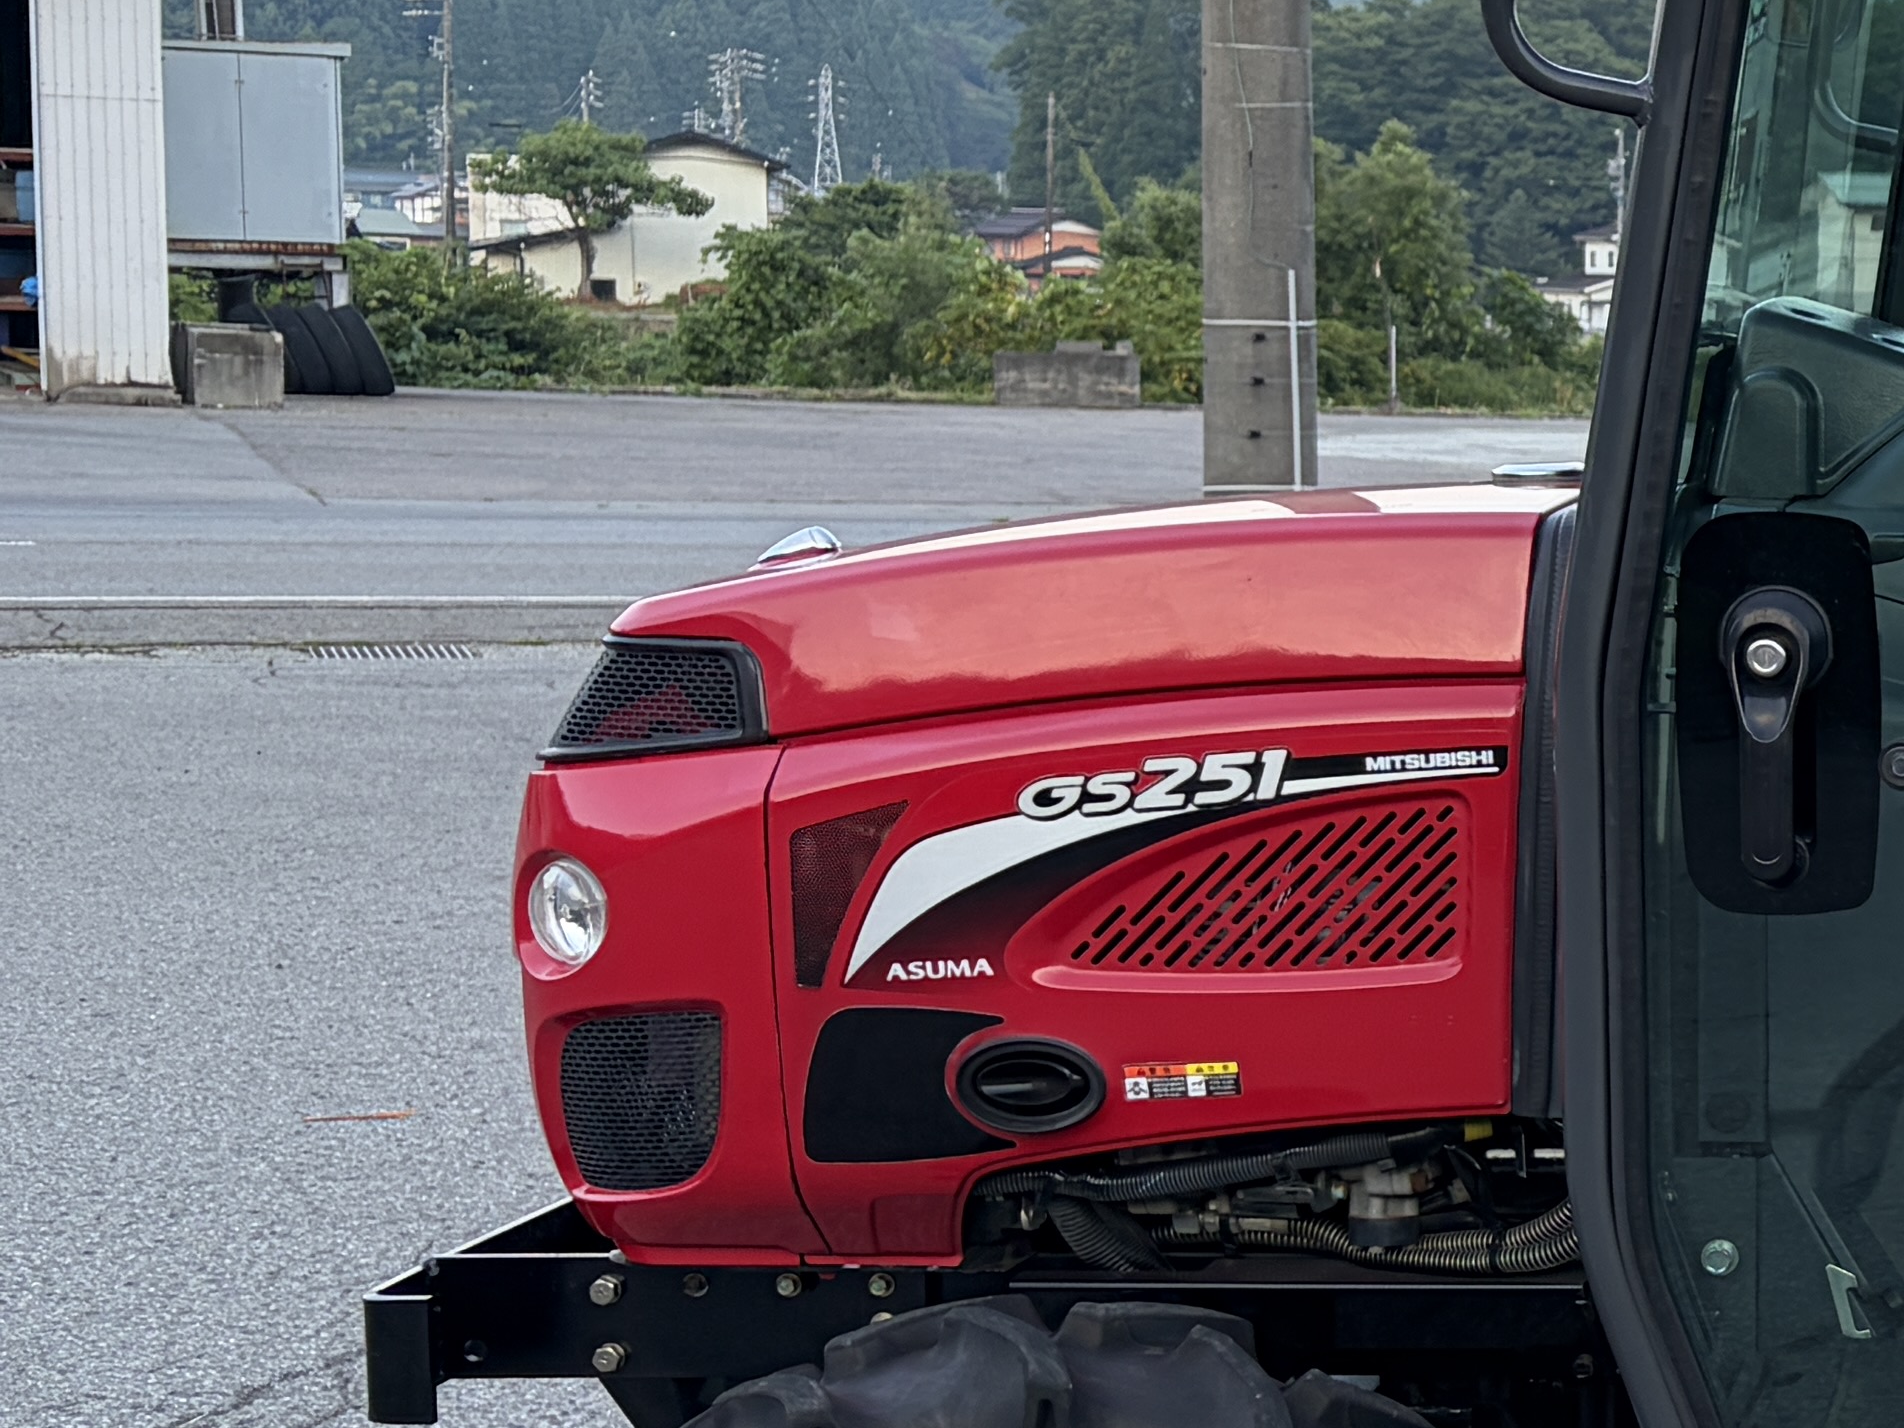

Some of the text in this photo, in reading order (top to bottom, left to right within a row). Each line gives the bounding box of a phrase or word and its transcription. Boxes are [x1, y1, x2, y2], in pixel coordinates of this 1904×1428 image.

[1365, 750, 1495, 772] MITSUBISHI
[1016, 748, 1289, 819] GS251
[886, 958, 995, 982] ASUMA
